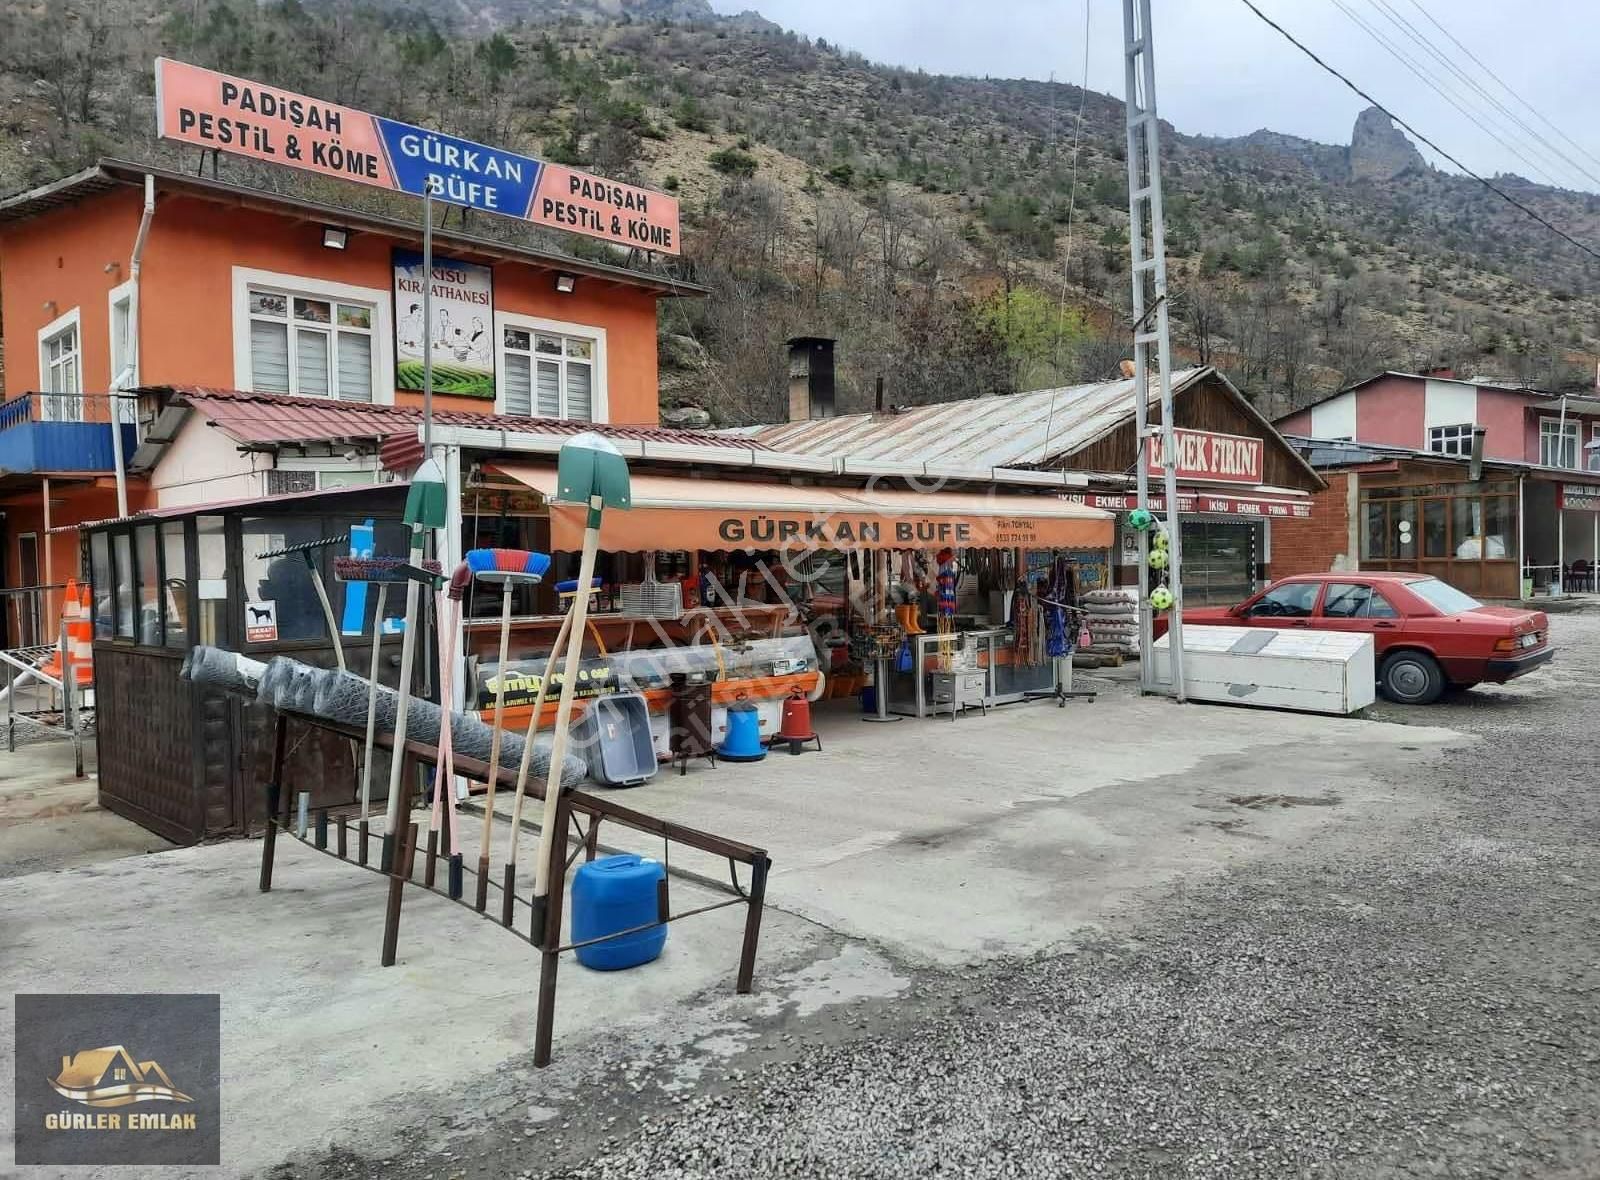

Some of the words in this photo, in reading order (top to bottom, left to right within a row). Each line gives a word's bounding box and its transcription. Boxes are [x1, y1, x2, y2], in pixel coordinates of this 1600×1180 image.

[286, 134, 302, 161] &
[312, 138, 379, 179] KÖME
[400, 134, 522, 184] GÜRKAN
[427, 172, 498, 208] BÜFE
[610, 215, 622, 236] &
[628, 217, 672, 248] KÖME
[1210, 437, 1258, 477] FIRINI
[1095, 495, 1127, 509] EKMEK
[719, 515, 880, 542] GÜRKAN
[895, 519, 970, 542] BÜFE
